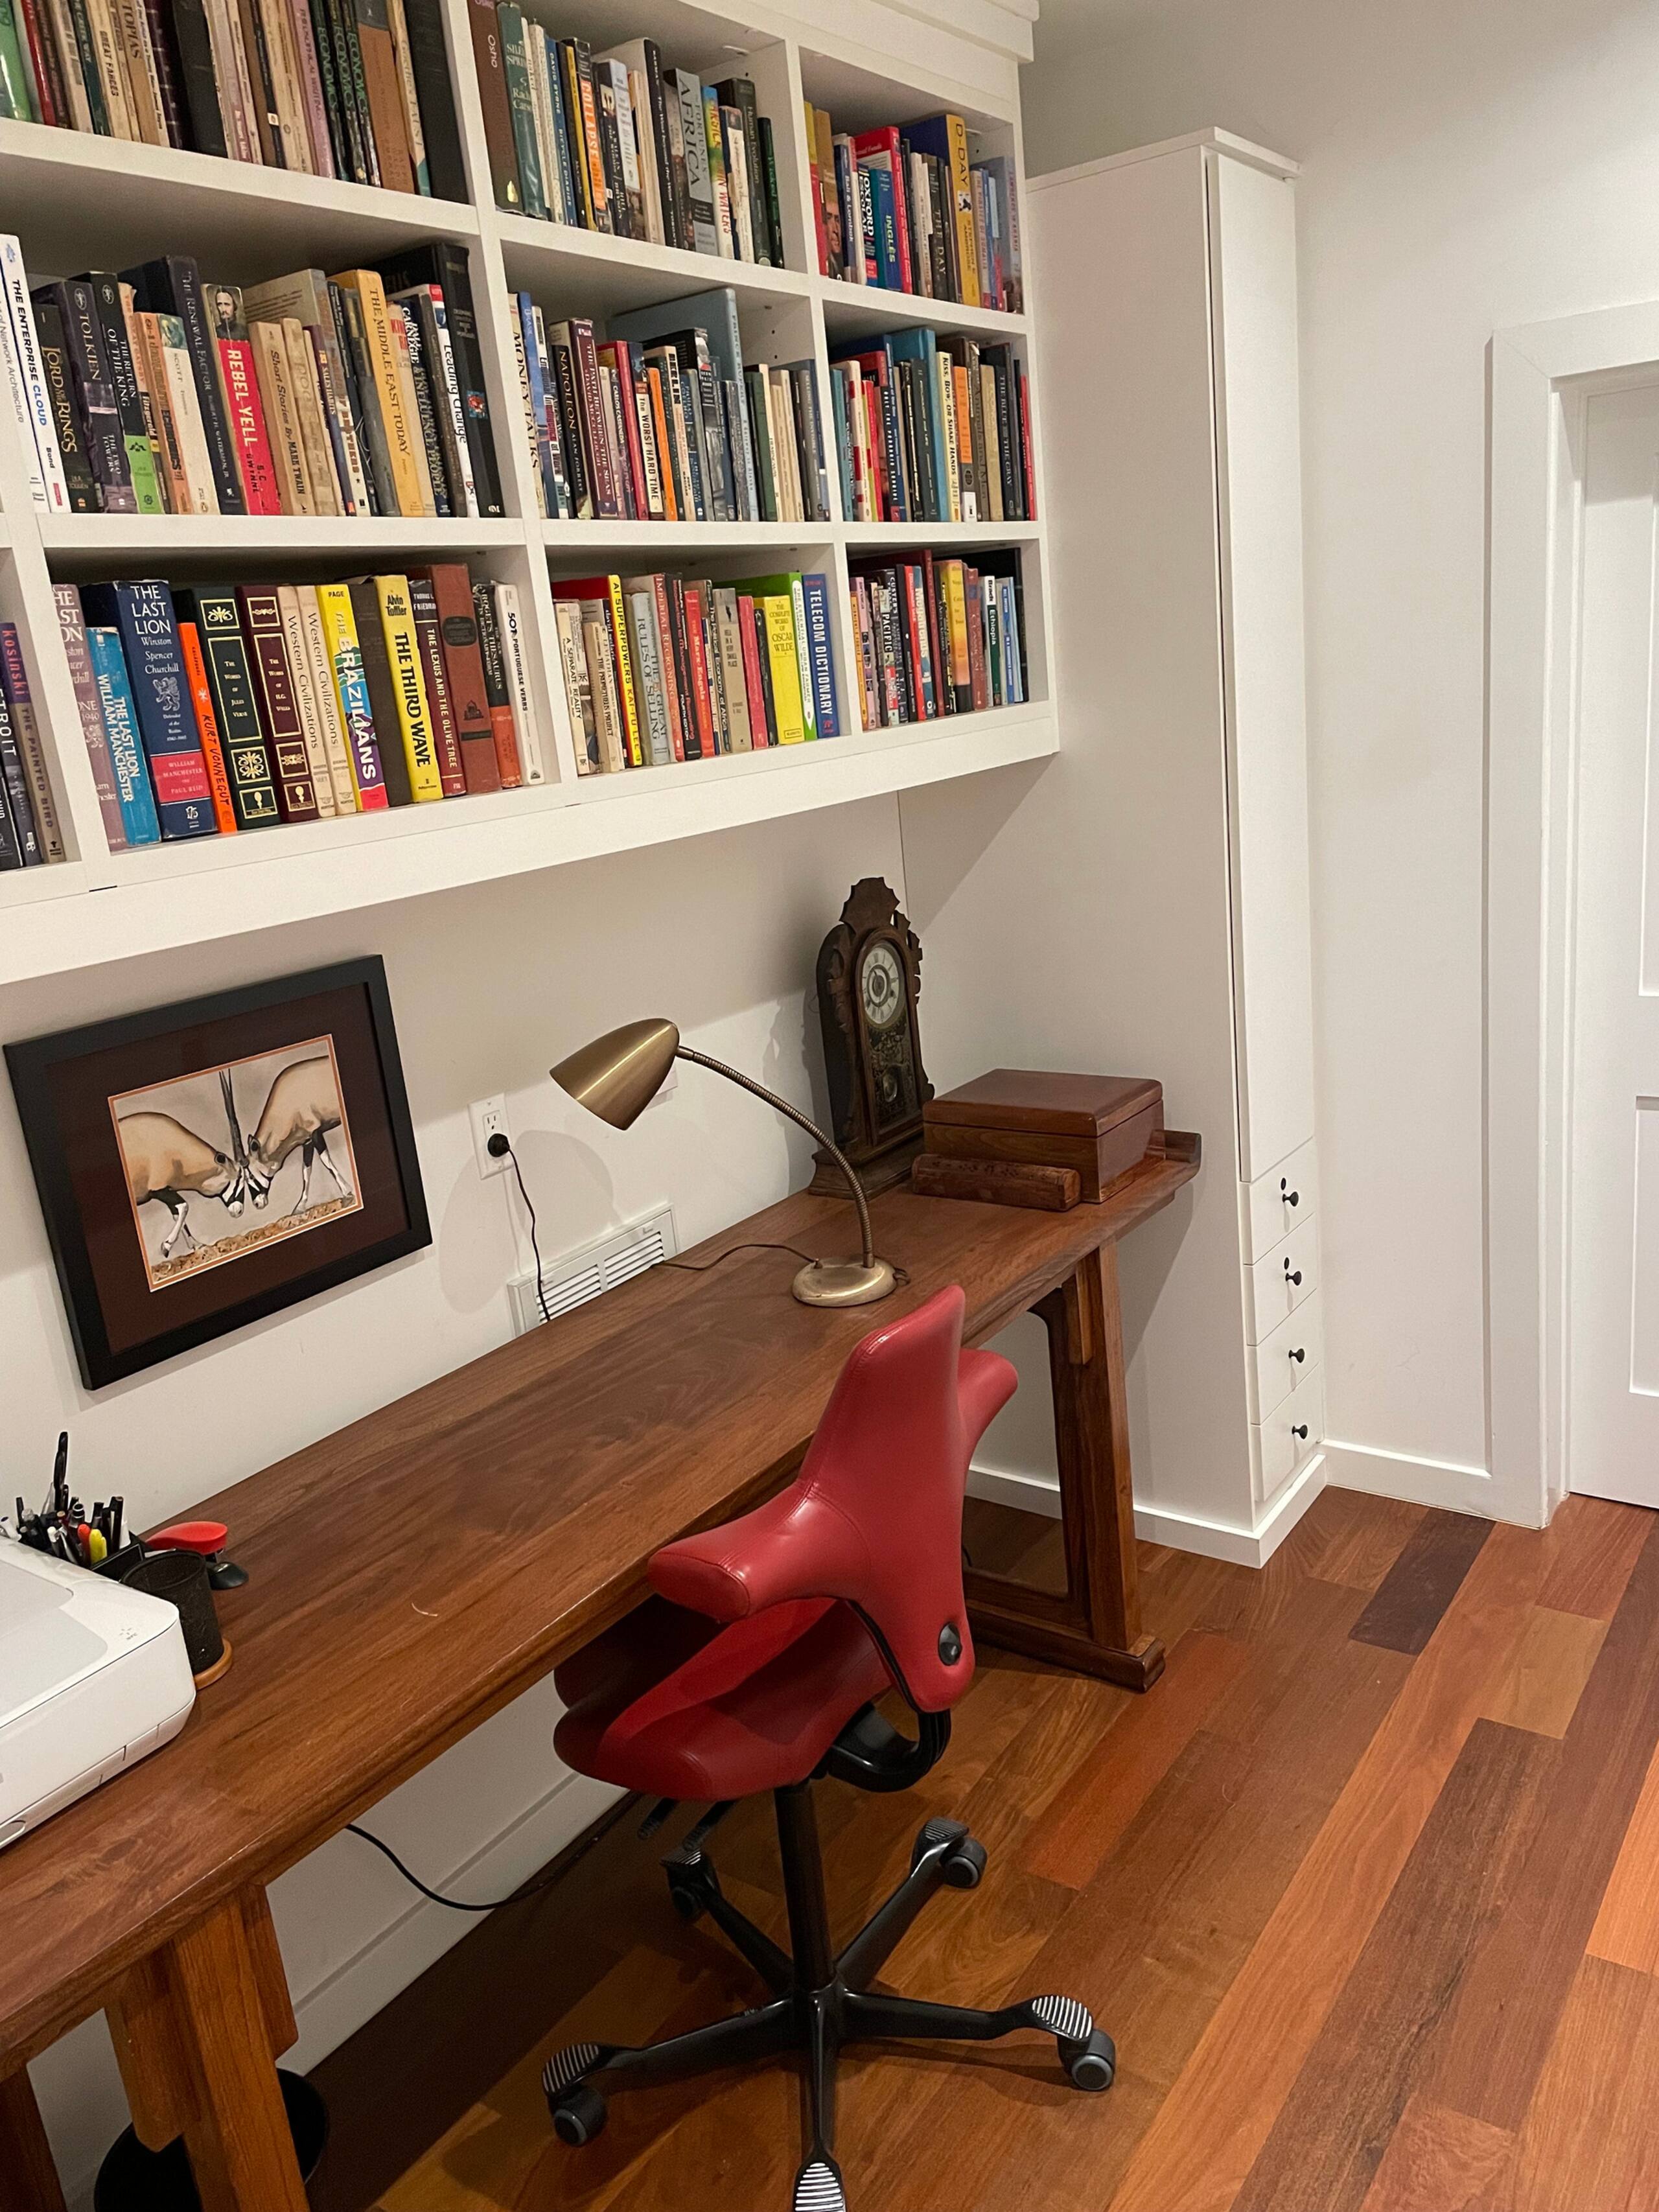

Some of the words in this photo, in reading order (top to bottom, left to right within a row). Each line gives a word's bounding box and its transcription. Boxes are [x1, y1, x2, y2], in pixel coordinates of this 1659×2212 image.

[318, 27, 338, 109] ECONOMICS
[334, 27, 354, 107] ECONOMICS
[487, 34, 498, 68] Osho
[105, 62, 119, 97] FARCES
[347, 32, 367, 113] ECONOMICS
[581, 83, 597, 158] COLLAPSE
[679, 77, 701, 186] AFRICA
[694, 104, 707, 172] FORTUNES
[747, 106, 756, 139] Human
[553, 84, 562, 115] BYRNE
[563, 170, 573, 207] DIARIES
[750, 141, 760, 184] Evolution
[955, 123, 968, 187] D-DAY
[859, 176, 868, 233] ESCOLAR
[863, 176, 875, 237] OXFORD
[934, 209, 942, 239] THE
[937, 246, 946, 275] DAY
[12, 279, 25, 303] THE
[369, 288, 382, 315] THE
[16, 307, 38, 382] ENTERPRISE
[78, 313, 102, 380] TOLKIEN
[106, 329, 117, 346] OF
[185, 297, 203, 348] RENEWAL
[196, 350, 212, 390] FACTOR
[374, 318, 392, 371] MIDDLE
[402, 307, 420, 364] CARNEGIE
[586, 343, 595, 364] THE
[41, 346, 64, 388] LORD
[111, 347, 124, 375] THE
[119, 339, 128, 358] THE
[124, 361, 137, 399] RETURN
[270, 349, 283, 382] Short
[590, 367, 599, 393] PATH
[669, 353, 681, 405] BERLIN
[32, 384, 47, 426] CLOUD
[114, 376, 129, 407] KING
[227, 349, 249, 401] REBEL
[238, 406, 258, 447] YELL
[277, 384, 290, 425] Stories
[322, 367, 331, 389] SALES
[327, 390, 336, 415] HABITS
[385, 373, 400, 408] EAST
[444, 345, 459, 395] Leading
[452, 399, 467, 443] Change
[513, 332, 529, 400] MONEY
[524, 412, 539, 469] TALKS
[559, 350, 576, 430] NAPOLEON
[56, 401, 78, 453] RINGS
[141, 395, 157, 436] Fitzgerald
[284, 427, 293, 439] By
[394, 413, 410, 456] TODAY
[594, 396, 605, 447] BETWEEN
[642, 415, 653, 448] WORST
[46, 447, 55, 469] Bond
[102, 435, 115, 473] TOWERS
[108, 434, 117, 450] THE
[113, 452, 122, 474] TWO
[288, 441, 299, 466] MARK
[646, 449, 655, 474] HARD
[294, 467, 305, 495] TWAIN
[603, 469, 612, 495] SEAS
[650, 478, 660, 500] TIME
[131, 585, 161, 600] THE
[387, 594, 404, 605] Alvin
[614, 583, 621, 594] AI
[889, 577, 899, 614] CUSTER'S
[132, 602, 167, 617] LAST
[135, 620, 171, 634] LION
[385, 605, 407, 617] Toffler
[809, 589, 826, 642] TELECOM
[915, 588, 929, 658] Megatrends
[141, 636, 172, 646] Winston
[393, 632, 412, 664] THE
[426, 629, 437, 647] THE
[480, 592, 493, 633] ROGET'S
[489, 636, 503, 690] THESAURUS
[615, 598, 632, 685] SUPERPOWERS
[636, 618, 649, 662] RULES
[655, 577, 666, 629] IMPERIAL
[662, 633, 675, 701] RECKONING
[712, 623, 720, 654] Political
[771, 633, 793, 641] OSCAR
[882, 614, 894, 653] PACIFIC
[3, 629, 28, 697] kosinski
[145, 651, 173, 661] Spencer
[145, 664, 180, 674] Churchill
[430, 649, 441, 676] LEXUS
[507, 612, 518, 634] 501
[513, 638, 526, 686] PORTUGUESE
[520, 688, 529, 712] VERBS
[642, 664, 653, 682] OF
[679, 640, 690, 696] Management
[286, 615, 304, 671] Western
[298, 674, 320, 749] Civilizations
[307, 612, 324, 667] Western
[318, 671, 340, 745] Civilizations
[400, 666, 419, 721] THIRD
[435, 678, 445, 695] AND
[566, 647, 577, 684] SEPARATE
[574, 688, 582, 719] REALITY
[714, 657, 723, 695] Economy
[815, 646, 833, 715] DICTIONARY
[21, 708, 34, 731] THE
[115, 697, 128, 719] THE
[439, 699, 449, 716] THE
[599, 671, 609, 711] PROMETHEUS
[605, 712, 613, 737] PROJECT
[627, 689, 637, 727] KAI-FU
[645, 684, 659, 739] SELLING
[719, 697, 725, 705] of
[97, 673, 117, 725] WILLIAM
[108, 728, 134, 803] MANCHESTER
[119, 720, 135, 747] LAST
[411, 721, 431, 767] WAVE
[442, 720, 454, 745] OLIVE
[25, 737, 46, 792] PAINTED
[124, 749, 141, 778] LION
[163, 767, 203, 777] MANCHESTER
[168, 760, 195, 769] WILLIAM
[202, 714, 216, 743] KURT
[209, 749, 230, 806] VONNEGUT
[447, 747, 458, 768] TREE
[40, 798, 53, 828] BIRD
